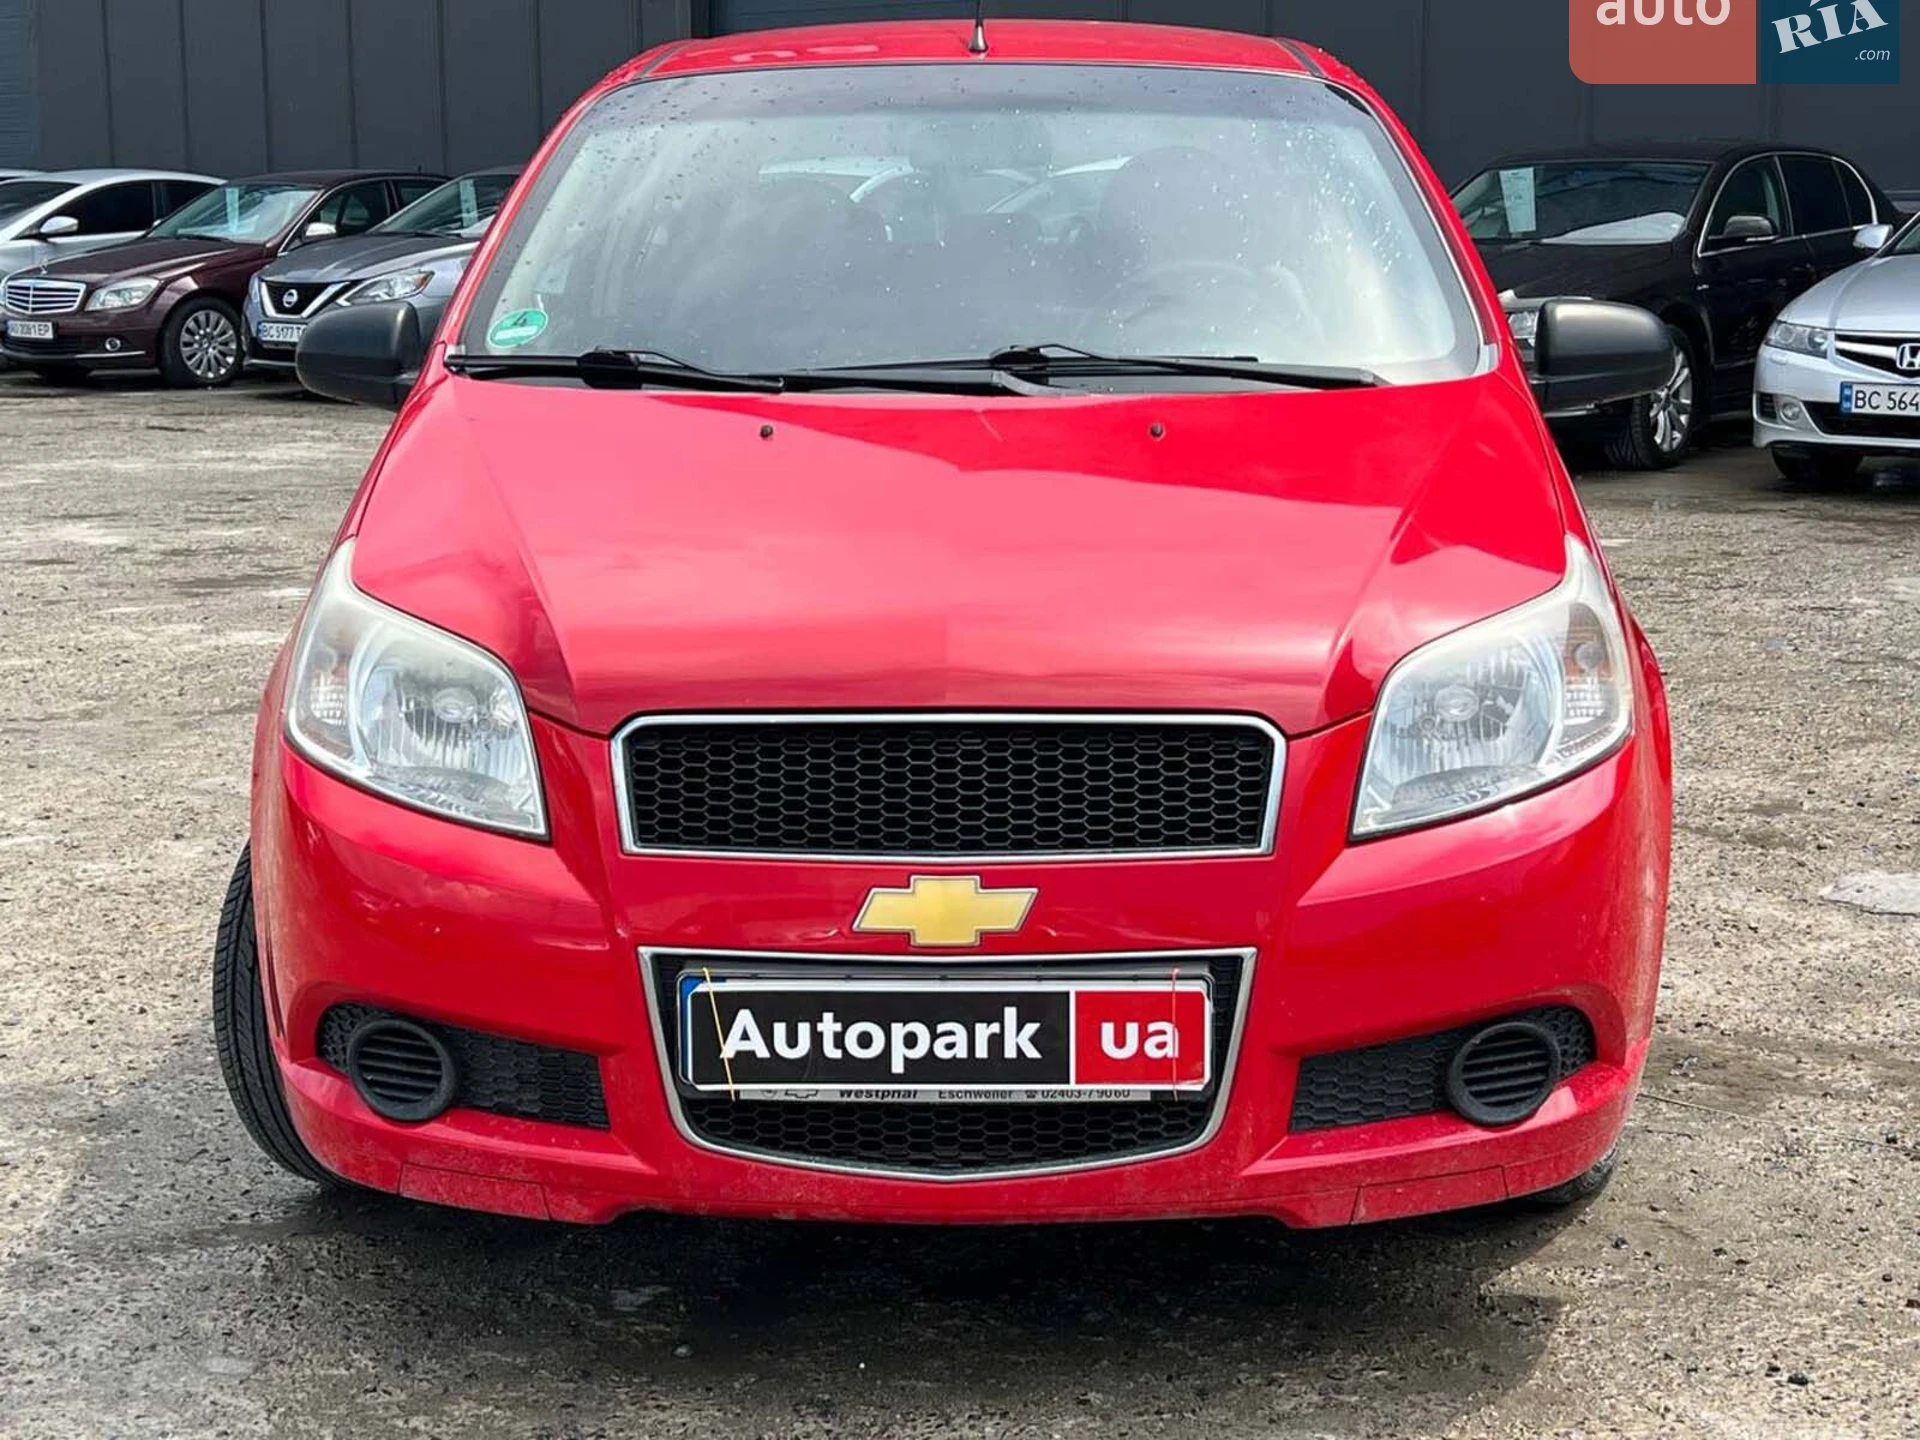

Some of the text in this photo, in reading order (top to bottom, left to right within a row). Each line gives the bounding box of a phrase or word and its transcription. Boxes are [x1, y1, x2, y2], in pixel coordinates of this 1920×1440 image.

[1855, 390, 1882, 410] BC
[719, 1006, 1180, 1074] Autopark ua
